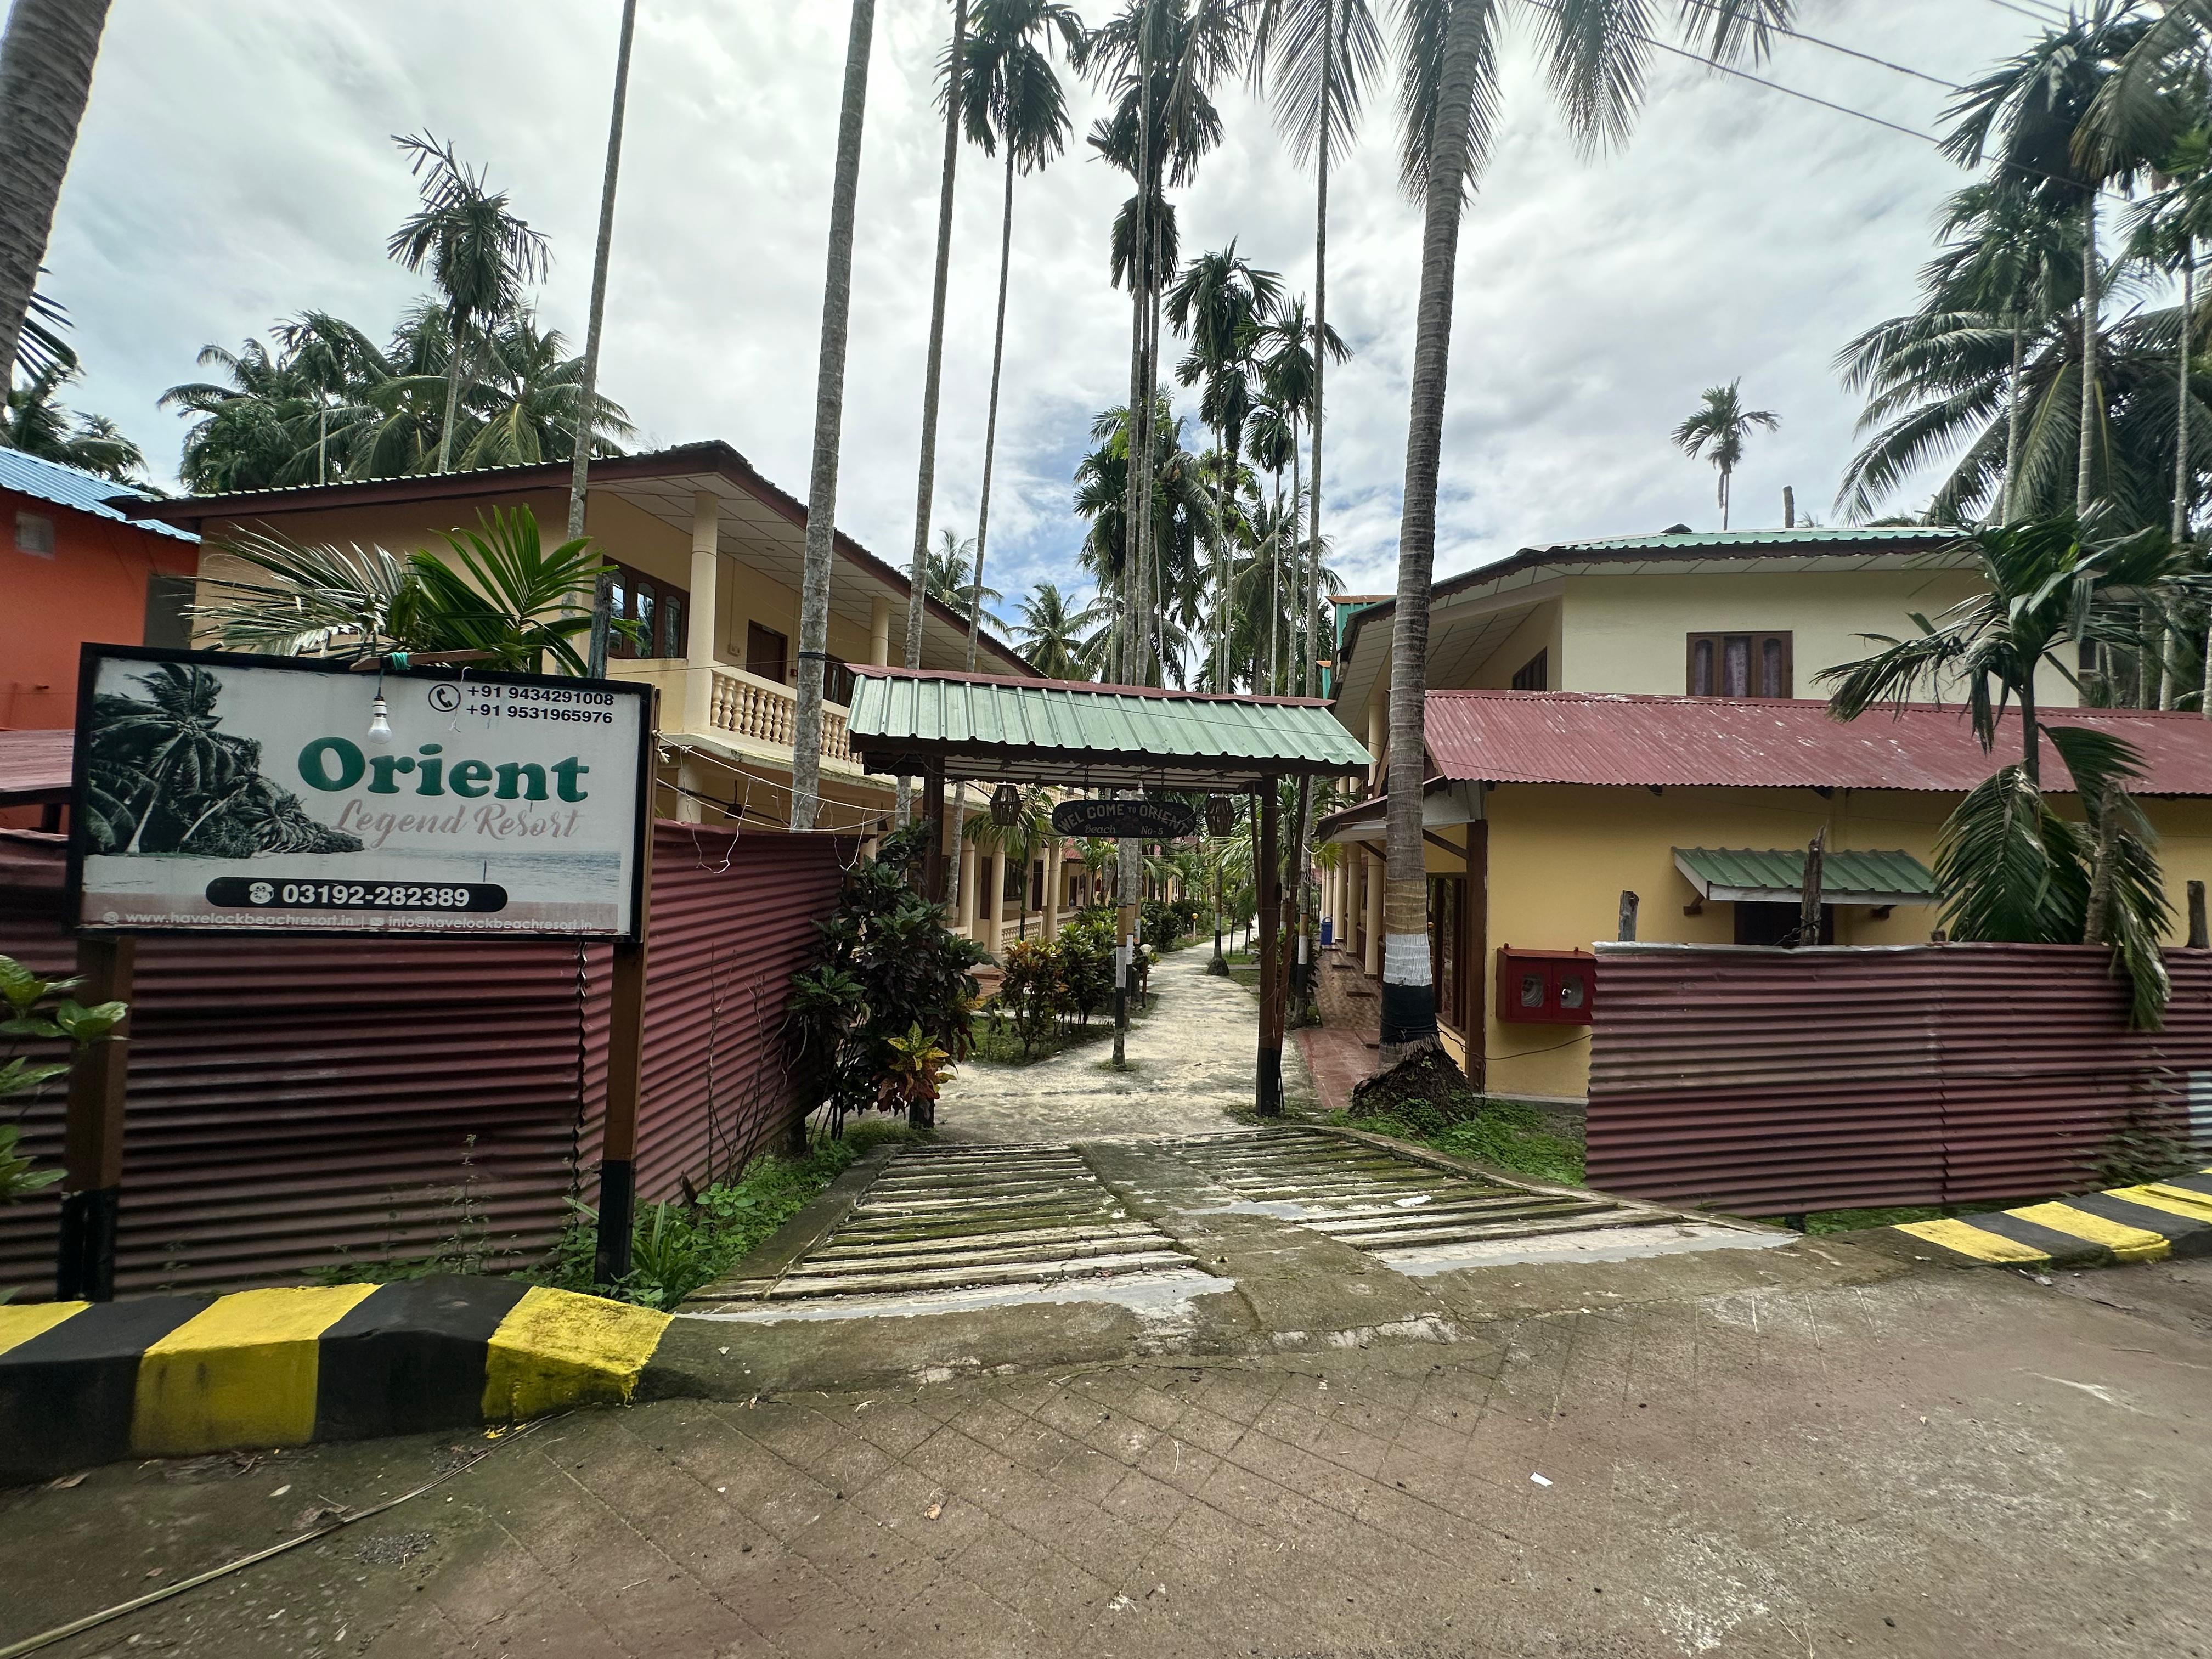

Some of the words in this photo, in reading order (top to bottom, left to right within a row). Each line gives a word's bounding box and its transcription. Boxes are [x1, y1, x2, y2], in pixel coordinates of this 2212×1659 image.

[467, 686, 501, 698] +91
[509, 687, 614, 706] 9434291008
[466, 704, 500, 716] +91
[507, 706, 613, 724] 9531965976
[298, 736, 590, 802] Orient
[331, 799, 465, 850] Legend
[474, 803, 585, 840] Resort
[1085, 823, 1116, 834] Beach
[1127, 806, 1137, 814] TO
[1139, 804, 1189, 834] ORIENT
[283, 884, 470, 907] 03192-282389
[125, 911, 354, 927] www.havelockbeachresort.in
[388, 916, 593, 931] info@havelockbeachresort.in
